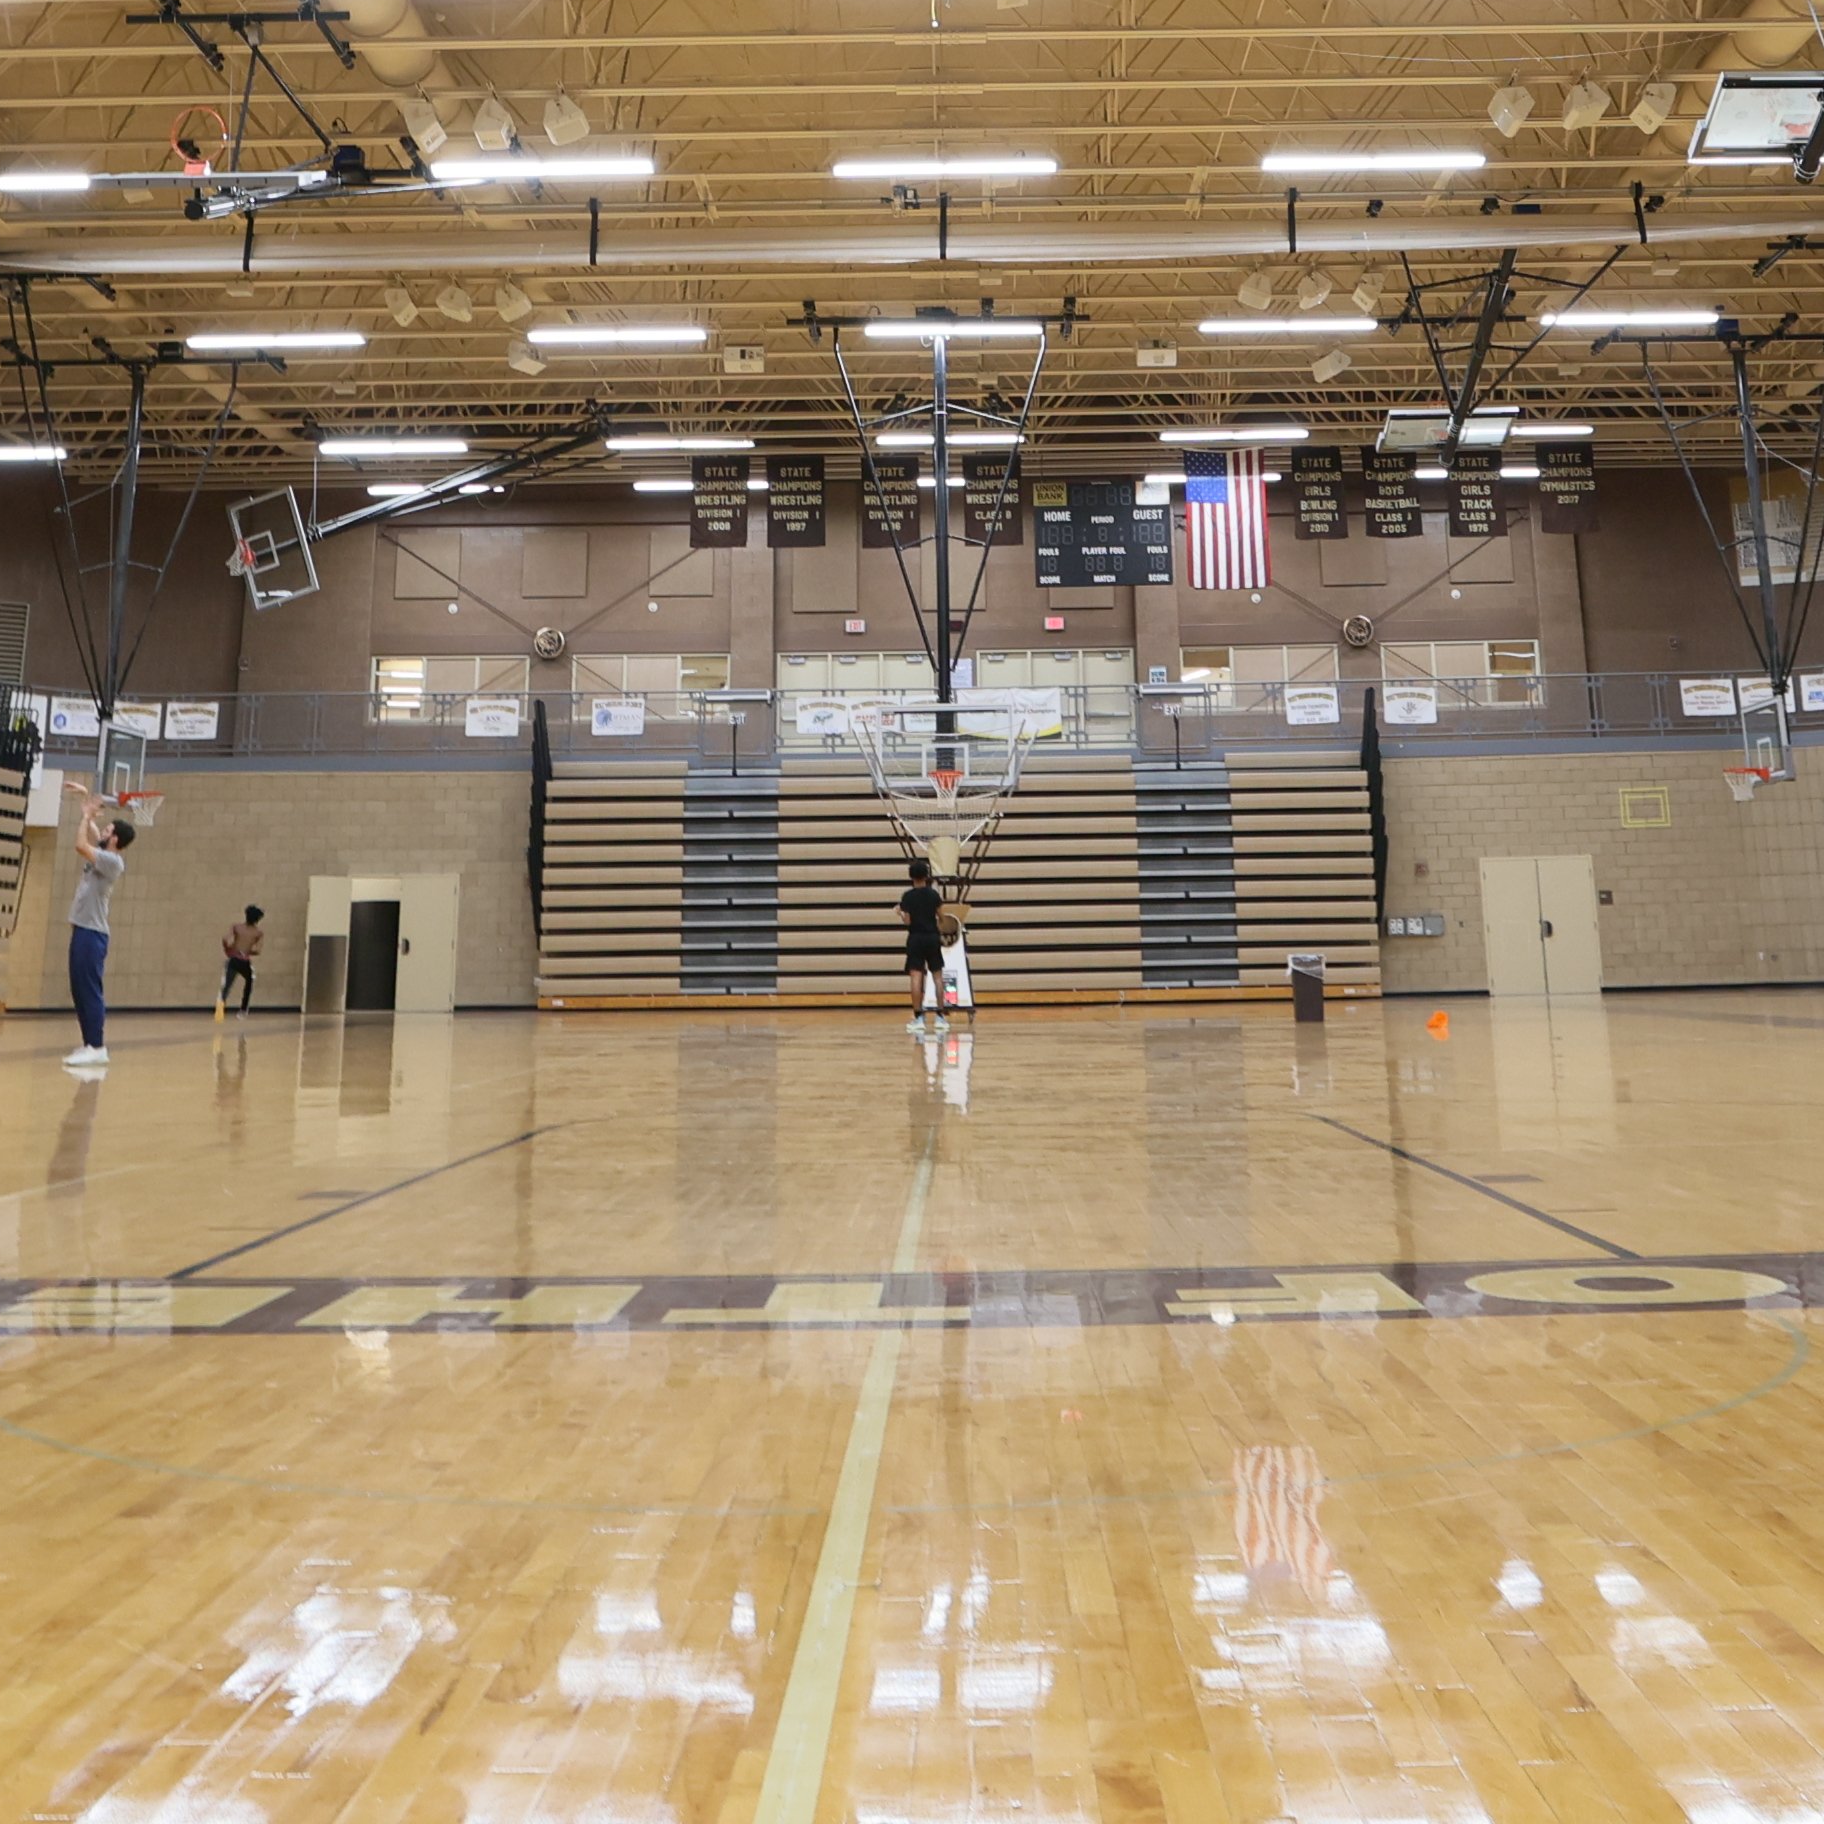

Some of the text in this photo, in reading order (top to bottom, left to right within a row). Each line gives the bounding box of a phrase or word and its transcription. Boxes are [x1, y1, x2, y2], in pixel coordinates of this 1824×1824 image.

[1301, 458, 1331, 468] STATE
[1373, 458, 1405, 468] STATE
[1459, 457, 1489, 467] STATE
[1548, 453, 1581, 463] STATE
[704, 467, 738, 476] STATE
[780, 467, 811, 476] STATE
[875, 467, 905, 476] STATE
[977, 465, 1008, 475] STATE
[1540, 468, 1592, 477] CHAMPIONS
[1295, 472, 1342, 482] CHAMPIONS
[1365, 470, 1415, 482] CHAMPIONS
[1449, 471, 1500, 481] CHAMPIONS
[694, 481, 747, 491] CHAMPIONS
[769, 481, 822, 491] CHAMPIONS
[1035, 484, 1065, 493] UNION
[1305, 486, 1331, 496] GIRLS
[1379, 485, 1404, 496] BOYS
[1461, 485, 1491, 496] GIRLS
[1539, 481, 1596, 492] GYMNASTICS
[694, 495, 746, 505] WRESTLING
[770, 495, 822, 505] WRESTLING
[966, 493, 1019, 504] WRESTING
[1037, 492, 1064, 500] BANK
[1557, 495, 1580, 504] 2007
[1300, 500, 1337, 510] BOWLING
[1365, 497, 1420, 510] BASKETBALL
[1460, 499, 1493, 509] TRACK
[697, 509, 733, 518] DIVISION
[773, 510, 809, 520] DIVISION
[1043, 511, 1071, 522] HOME
[1133, 509, 1164, 520] GUEST
[1301, 513, 1333, 522] DIVISION
[1375, 513, 1403, 522] CLASS
[1459, 512, 1486, 521] CLASS
[1090, 516, 1115, 524] PERIOD
[1309, 524, 1330, 533] 2010
[1381, 524, 1407, 534] 2005
[1468, 523, 1489, 533] 1976
[1038, 547, 1059, 556] FOULS
[1082, 547, 1126, 555] PLAYER FOUL
[1147, 546, 1168, 554] FOULS
[1039, 575, 1061, 584] SCORE
[1093, 574, 1116, 583] MATCH
[1148, 574, 1170, 582] SCORE
[1165, 1265, 1787, 1317] OF
